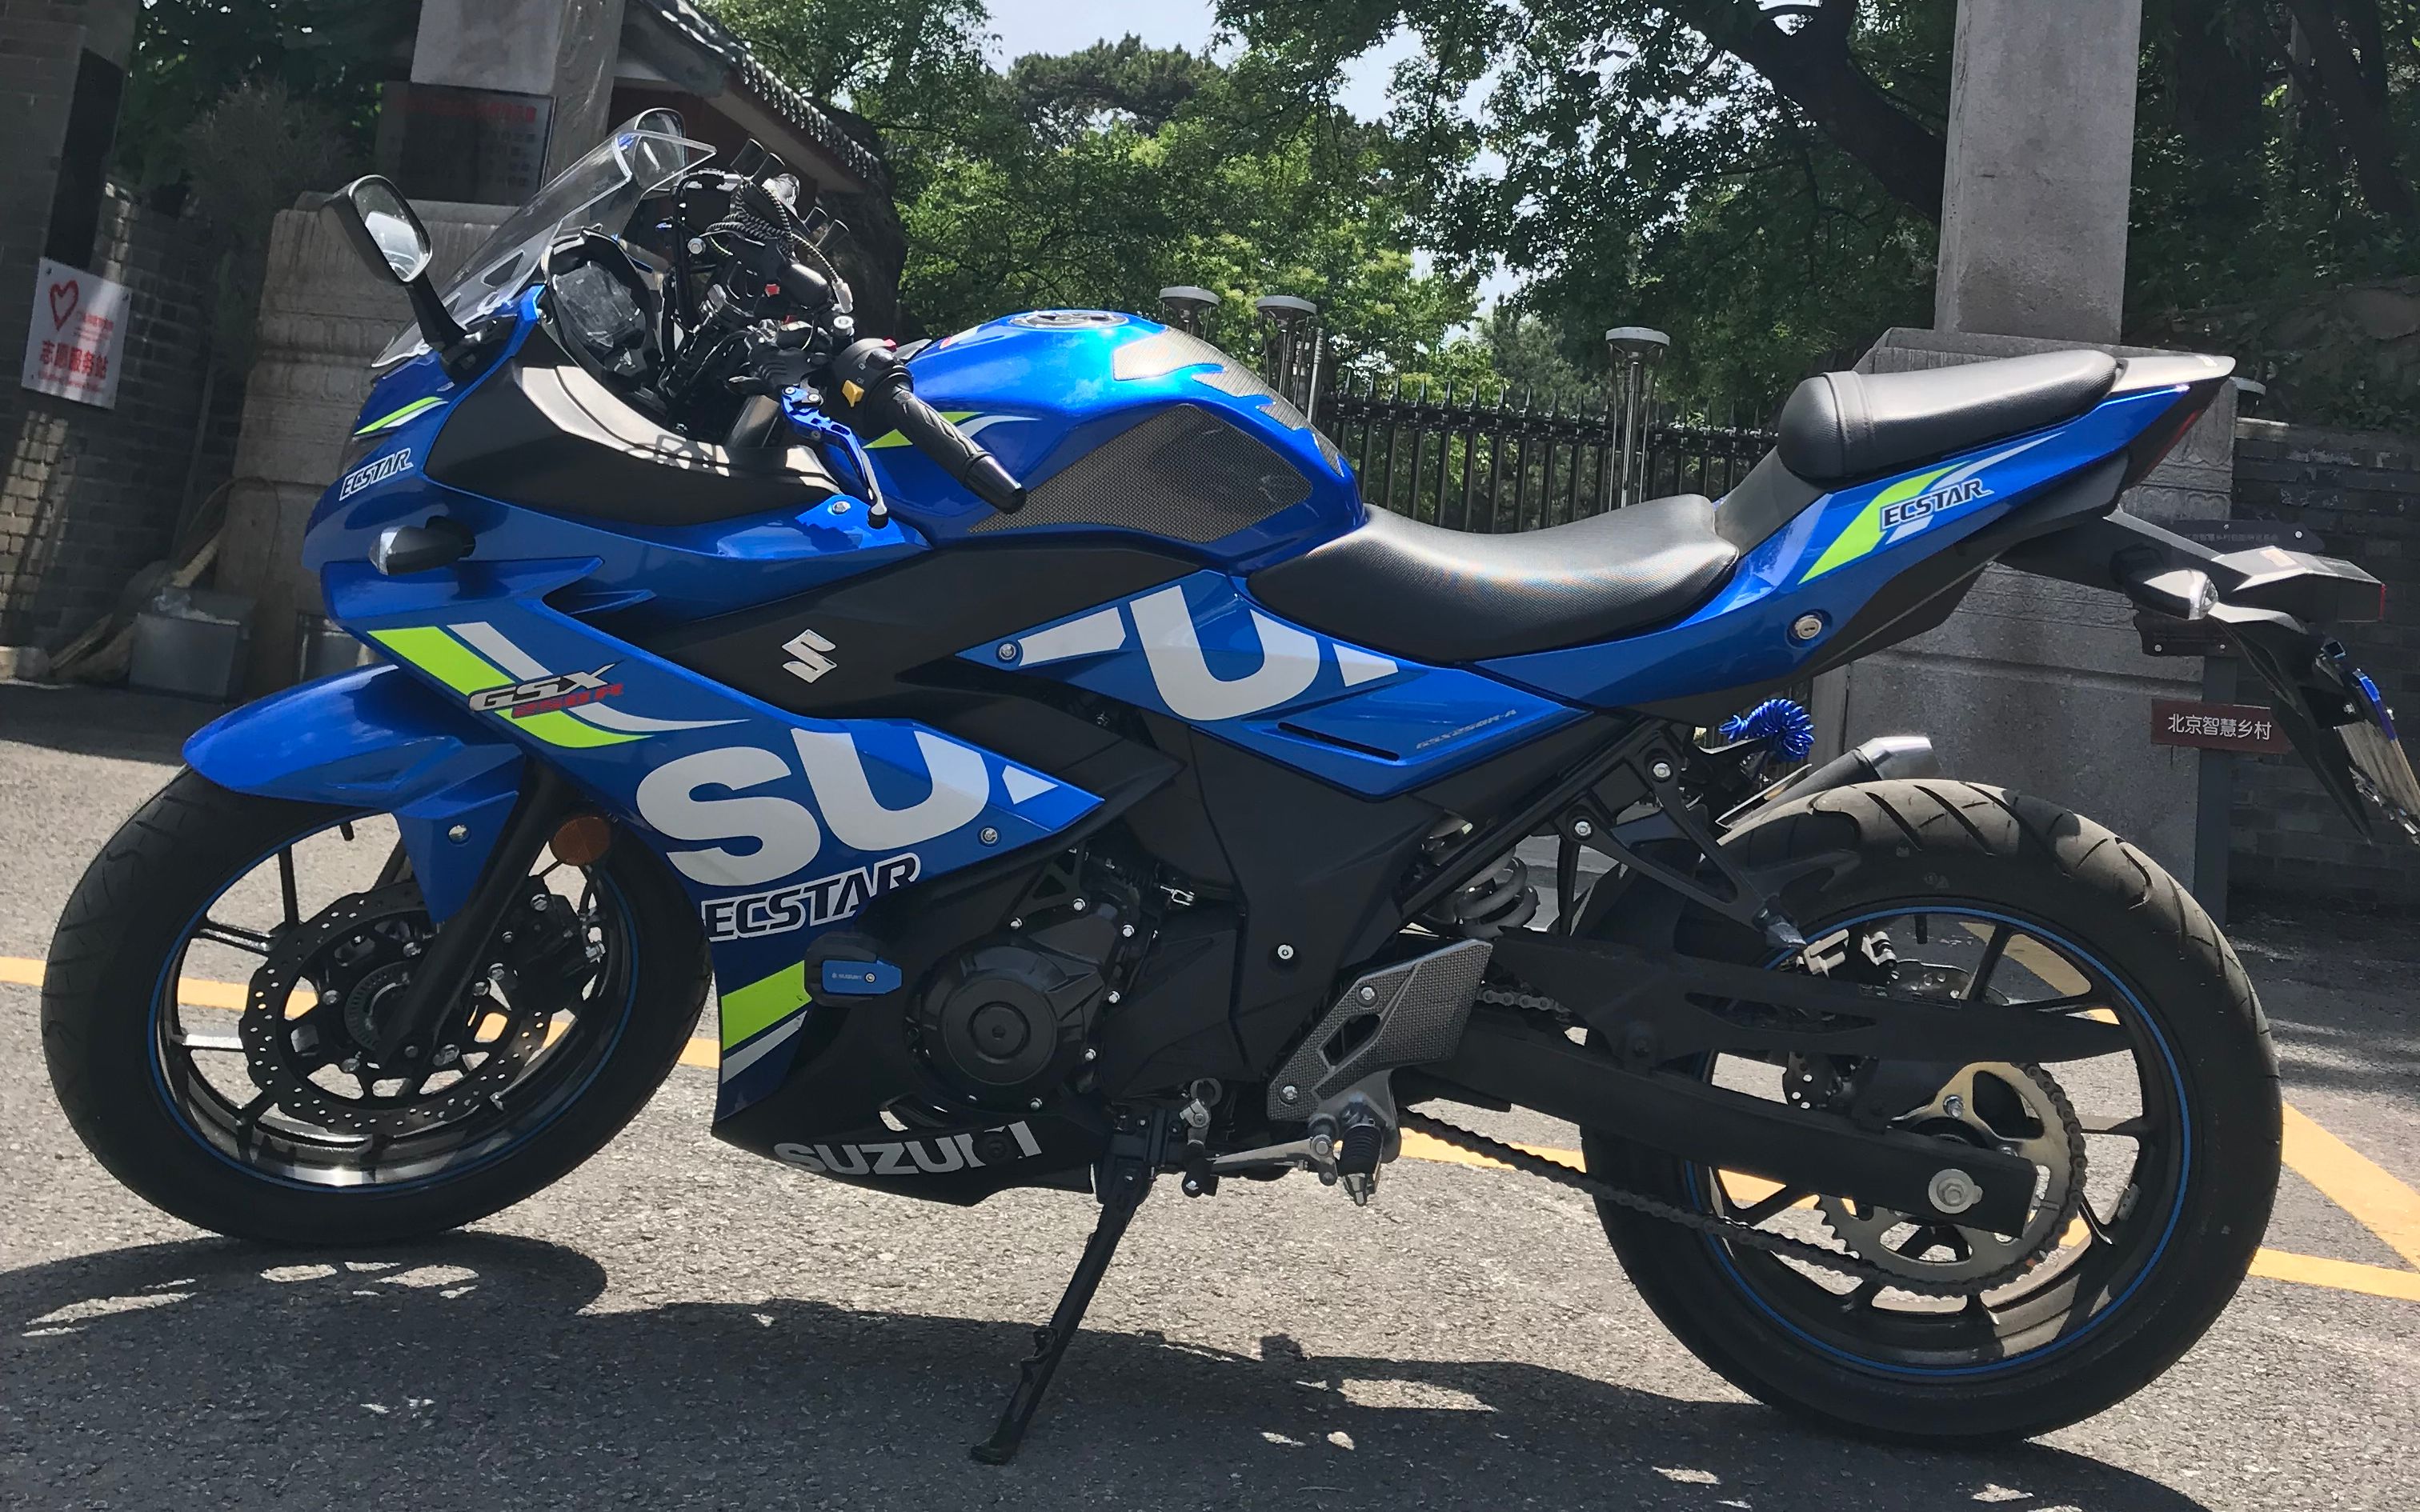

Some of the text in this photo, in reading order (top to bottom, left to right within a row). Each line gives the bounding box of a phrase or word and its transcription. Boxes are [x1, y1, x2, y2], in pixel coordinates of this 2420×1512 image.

[339, 447, 414, 502] ECSTAR
[1882, 478, 1995, 530] ECSTAR
[468, 663, 615, 712] GSX
[2167, 713, 2272, 740] 北京智慧乡村
[701, 852, 920, 942] ECSTAR
